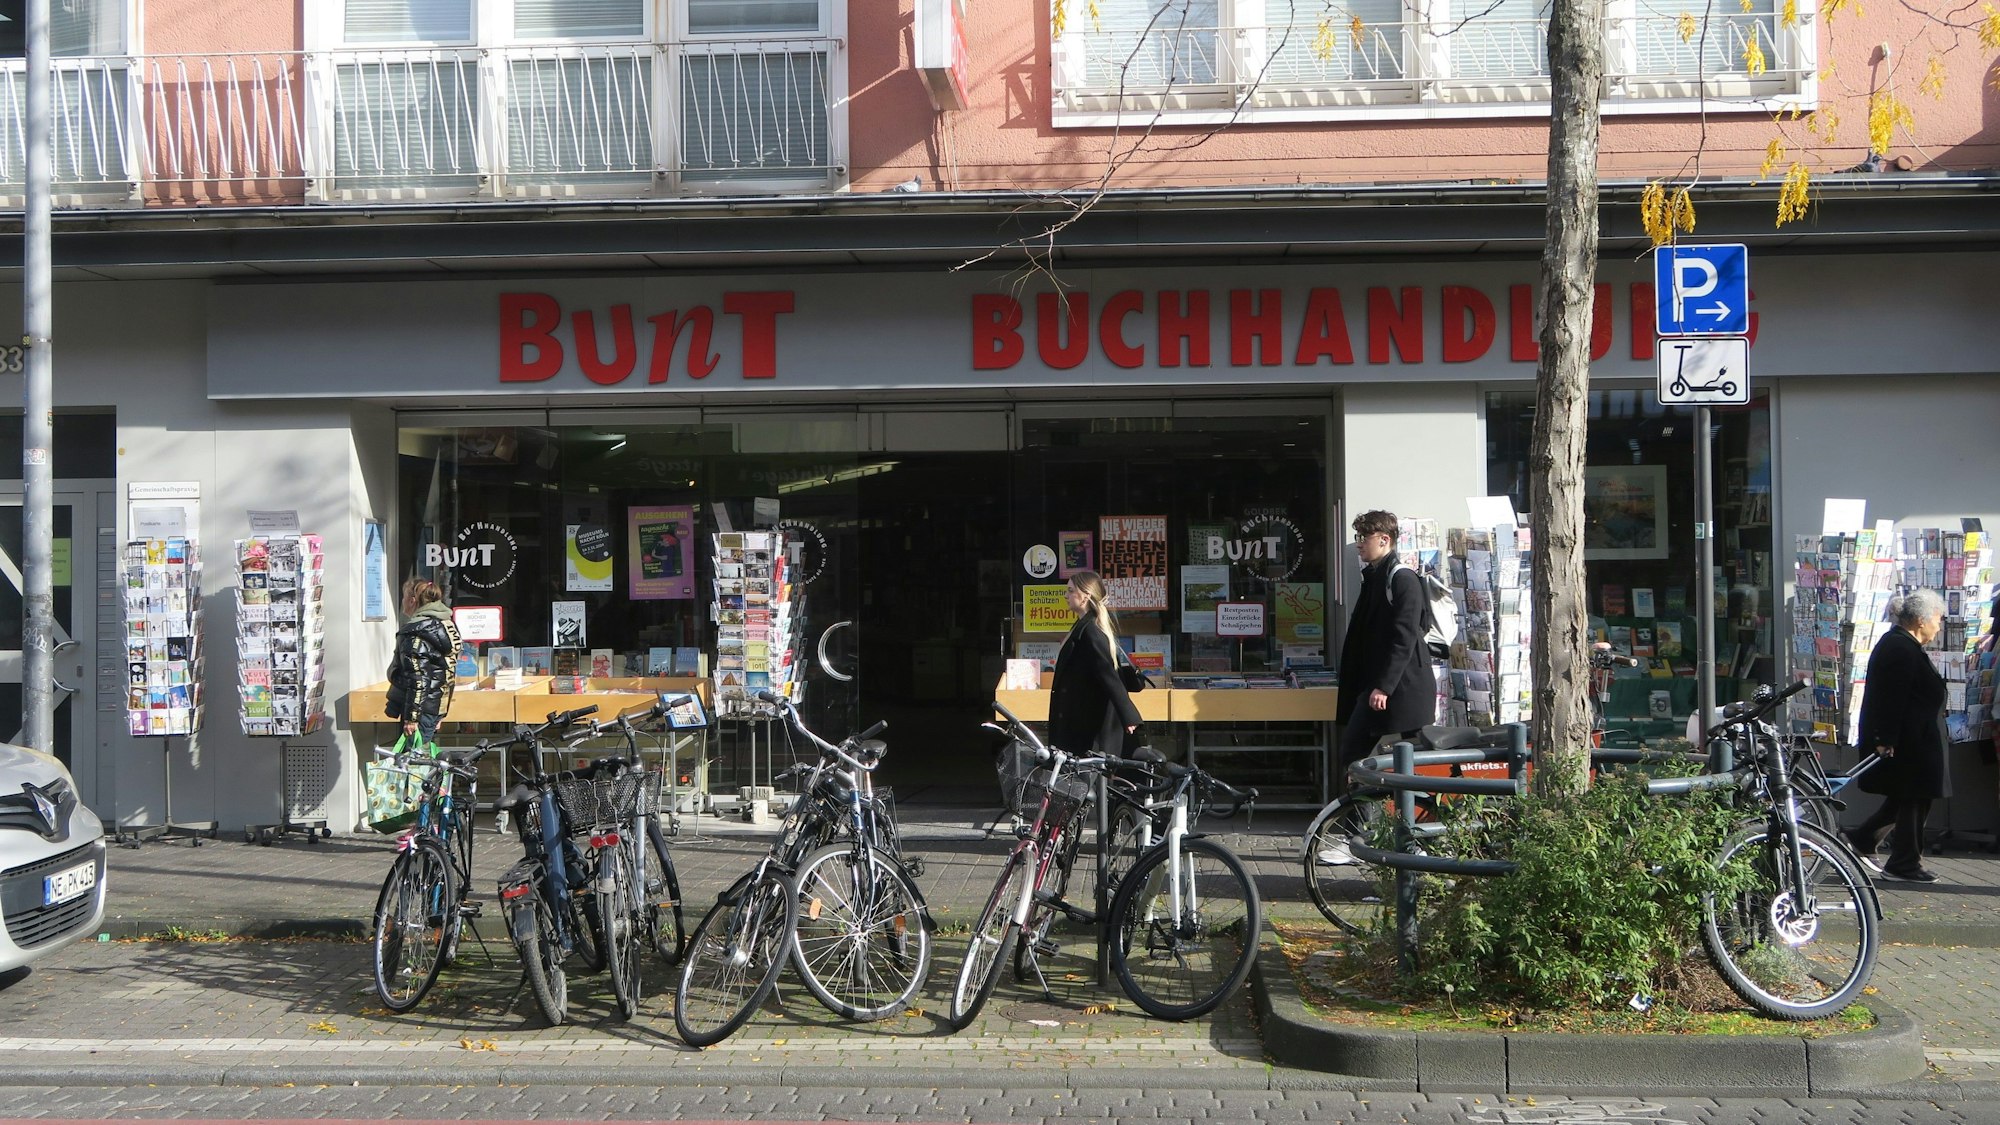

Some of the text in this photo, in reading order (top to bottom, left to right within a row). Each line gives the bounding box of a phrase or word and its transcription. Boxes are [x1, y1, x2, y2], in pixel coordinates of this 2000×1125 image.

[1673, 258, 1719, 323] P
[972, 281, 1759, 371] BUCHHANDL
[635, 511, 688, 519] AUSGEHEN!
[1101, 519, 1166, 531] NIE WIEDER
[578, 528, 604, 540] MUSEUMS
[579, 532, 610, 544] NACHT KÖLN
[1101, 529, 1166, 541] IST JETZT!
[1102, 540, 1166, 553] GEGEN
[1102, 551, 1166, 564] RECHTE
[1102, 562, 1166, 579] HETZE
[1122, 576, 1166, 588] VIELFALT
[1221, 622, 1262, 631] Schnäppchen
[52, 864, 94, 899] NE PK 413
